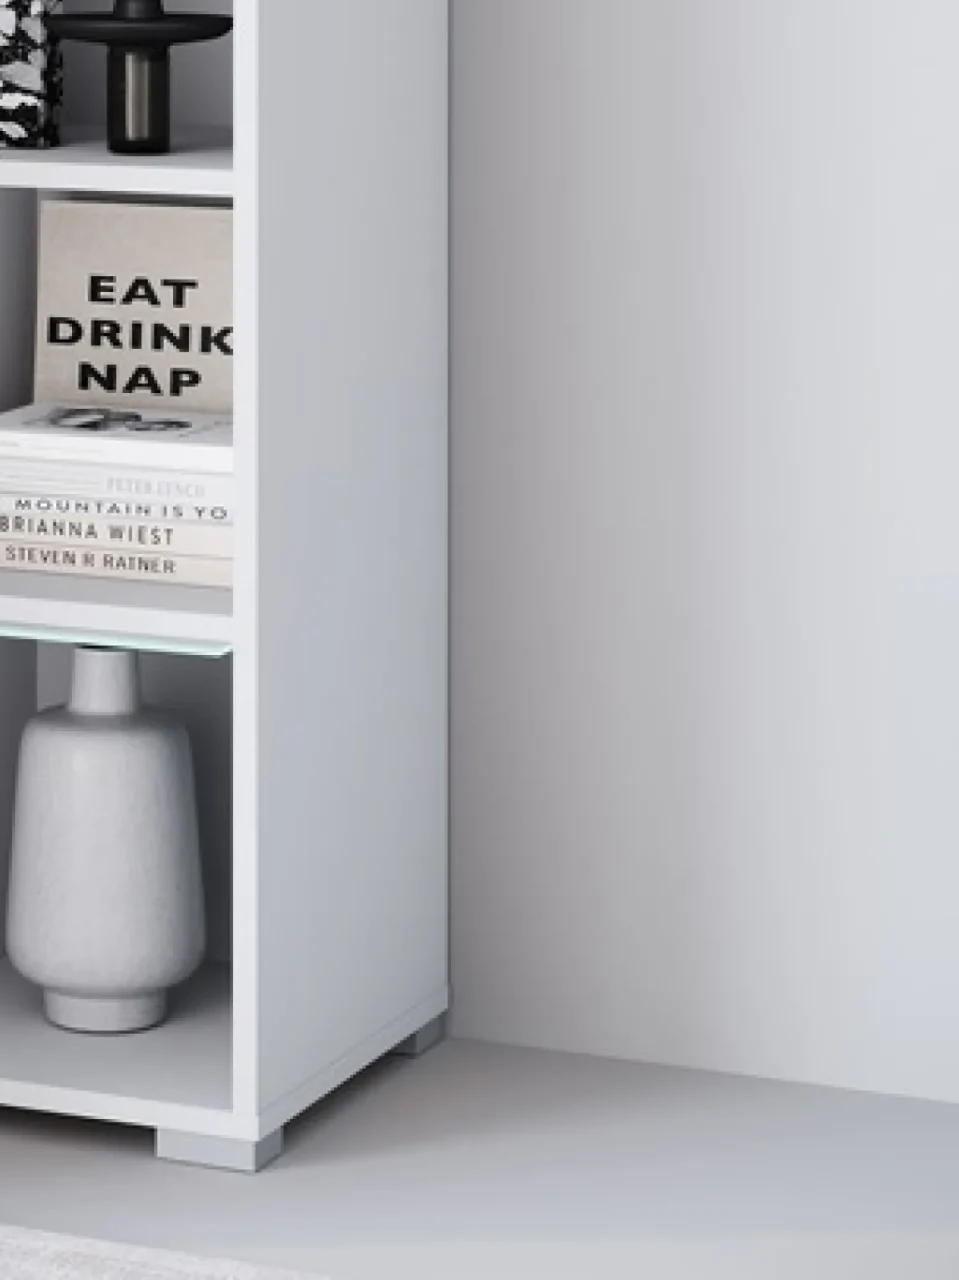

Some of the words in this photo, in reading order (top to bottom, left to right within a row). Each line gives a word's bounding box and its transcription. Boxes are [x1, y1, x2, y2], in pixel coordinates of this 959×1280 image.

[88, 274, 199, 308] EAT
[47, 316, 233, 355] DRINK
[77, 361, 202, 396] NAP
[14, 499, 151, 516] MOUNTAIN
[162, 505, 183, 518] IS
[0, 515, 98, 539] BRIANNA
[108, 523, 174, 546] WIEST
[5, 544, 76, 566] STEVEN
